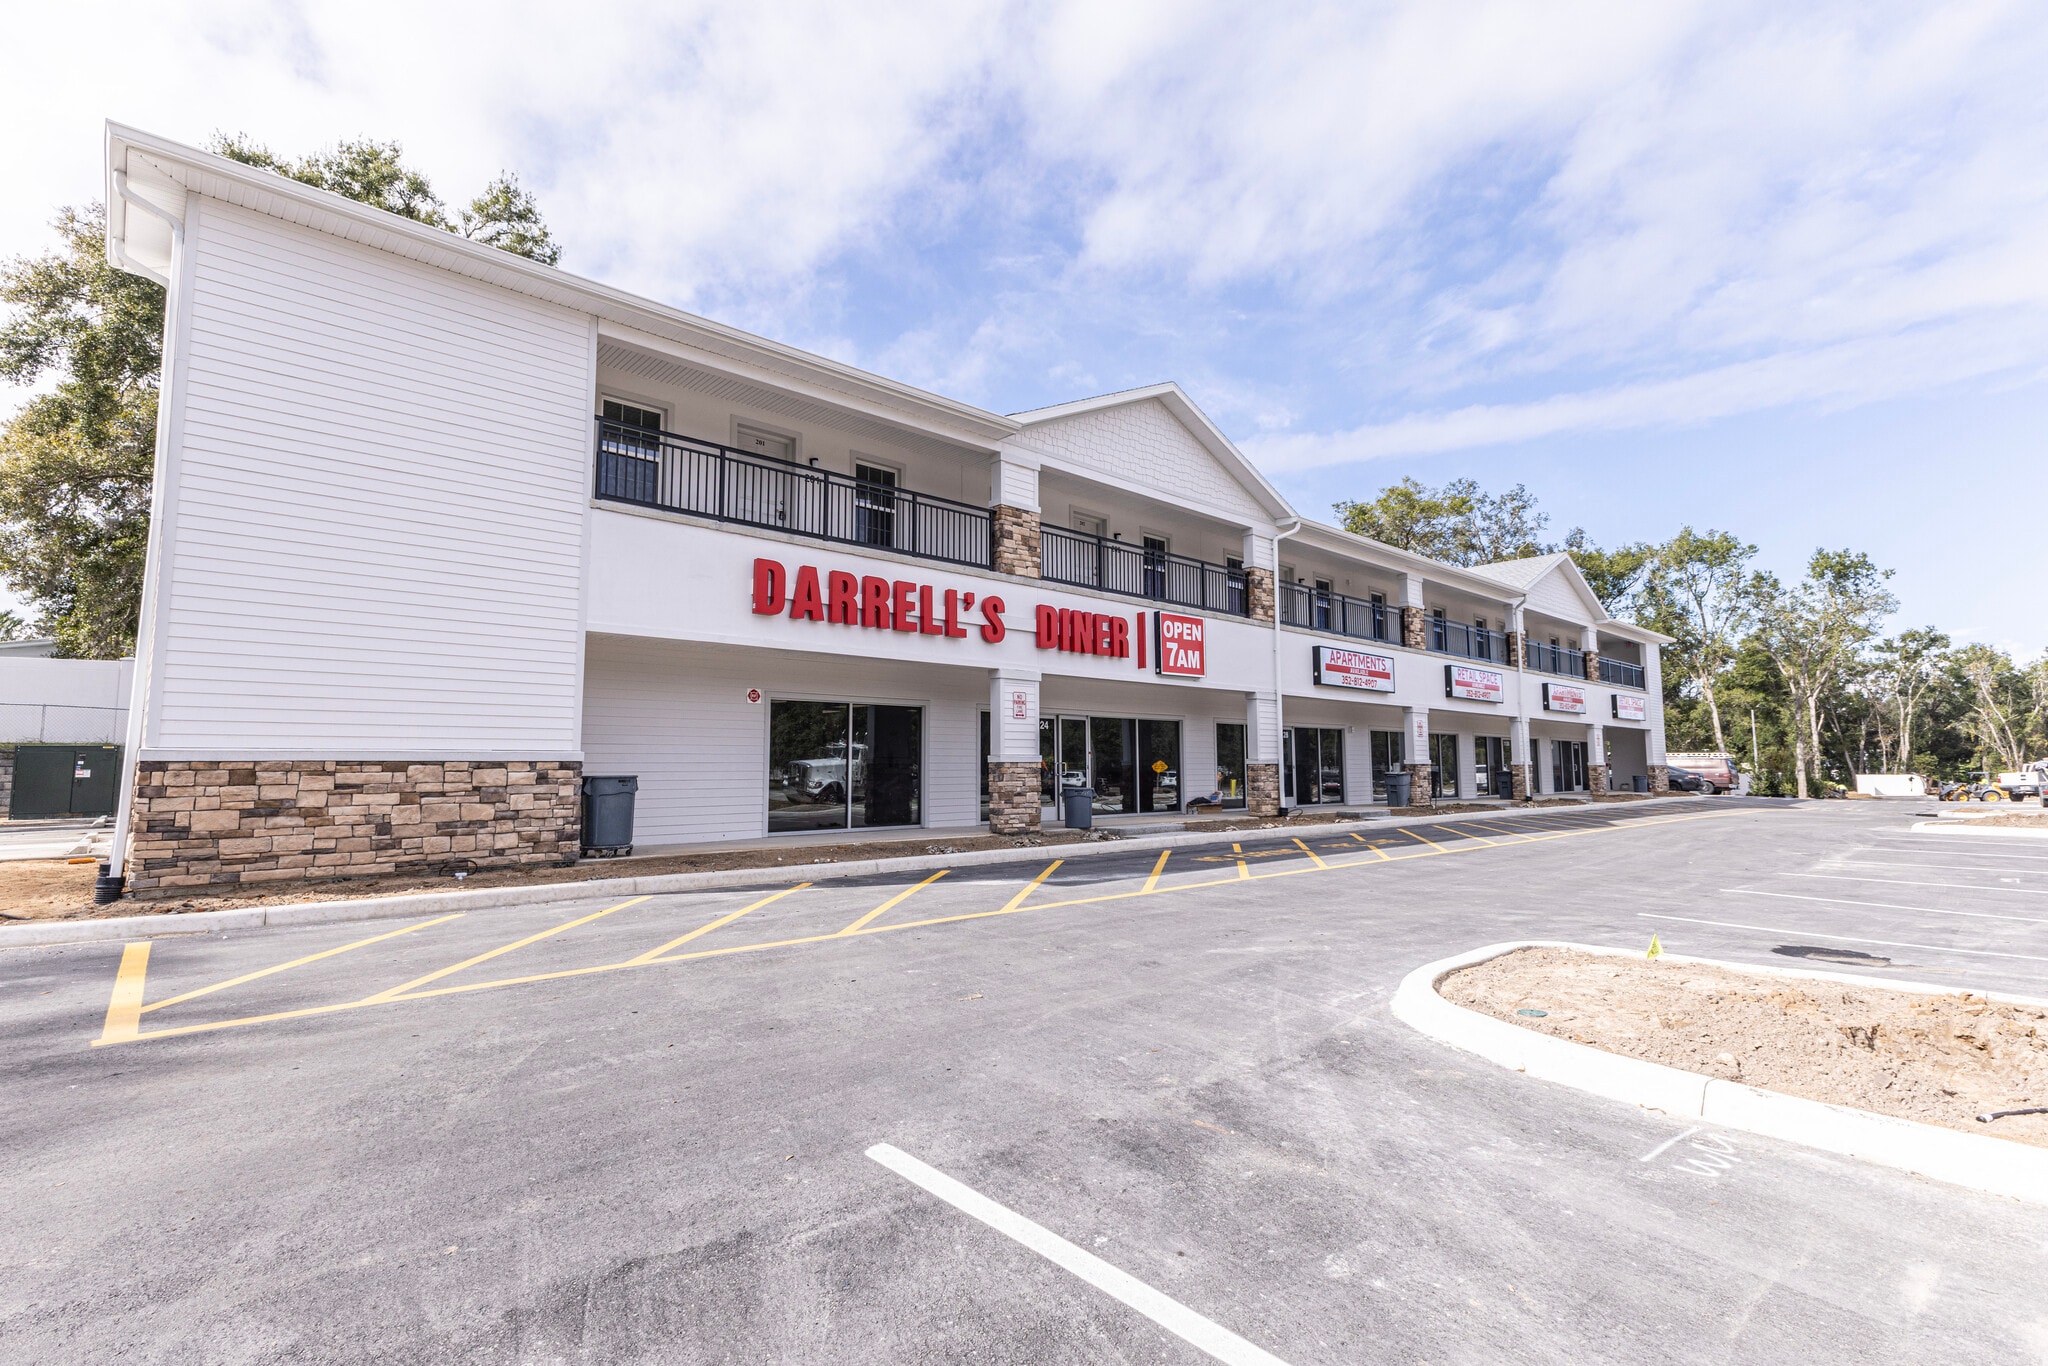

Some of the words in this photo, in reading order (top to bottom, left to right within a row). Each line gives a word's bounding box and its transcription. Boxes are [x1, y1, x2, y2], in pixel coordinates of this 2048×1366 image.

[752, 558, 1006, 643] DARRELL'S
[1036, 604, 1129, 658] DINER
[1163, 620, 1202, 641] OPEN
[1166, 642, 1200, 669] 7AM
[1329, 650, 1387, 672] APARTMENTS
[1341, 675, 1378, 688] 352-812-4907
[1457, 668, 1477, 682] RETAIL
[1479, 671, 1498, 685] SPACE
[1040, 720, 1049, 730] 24
